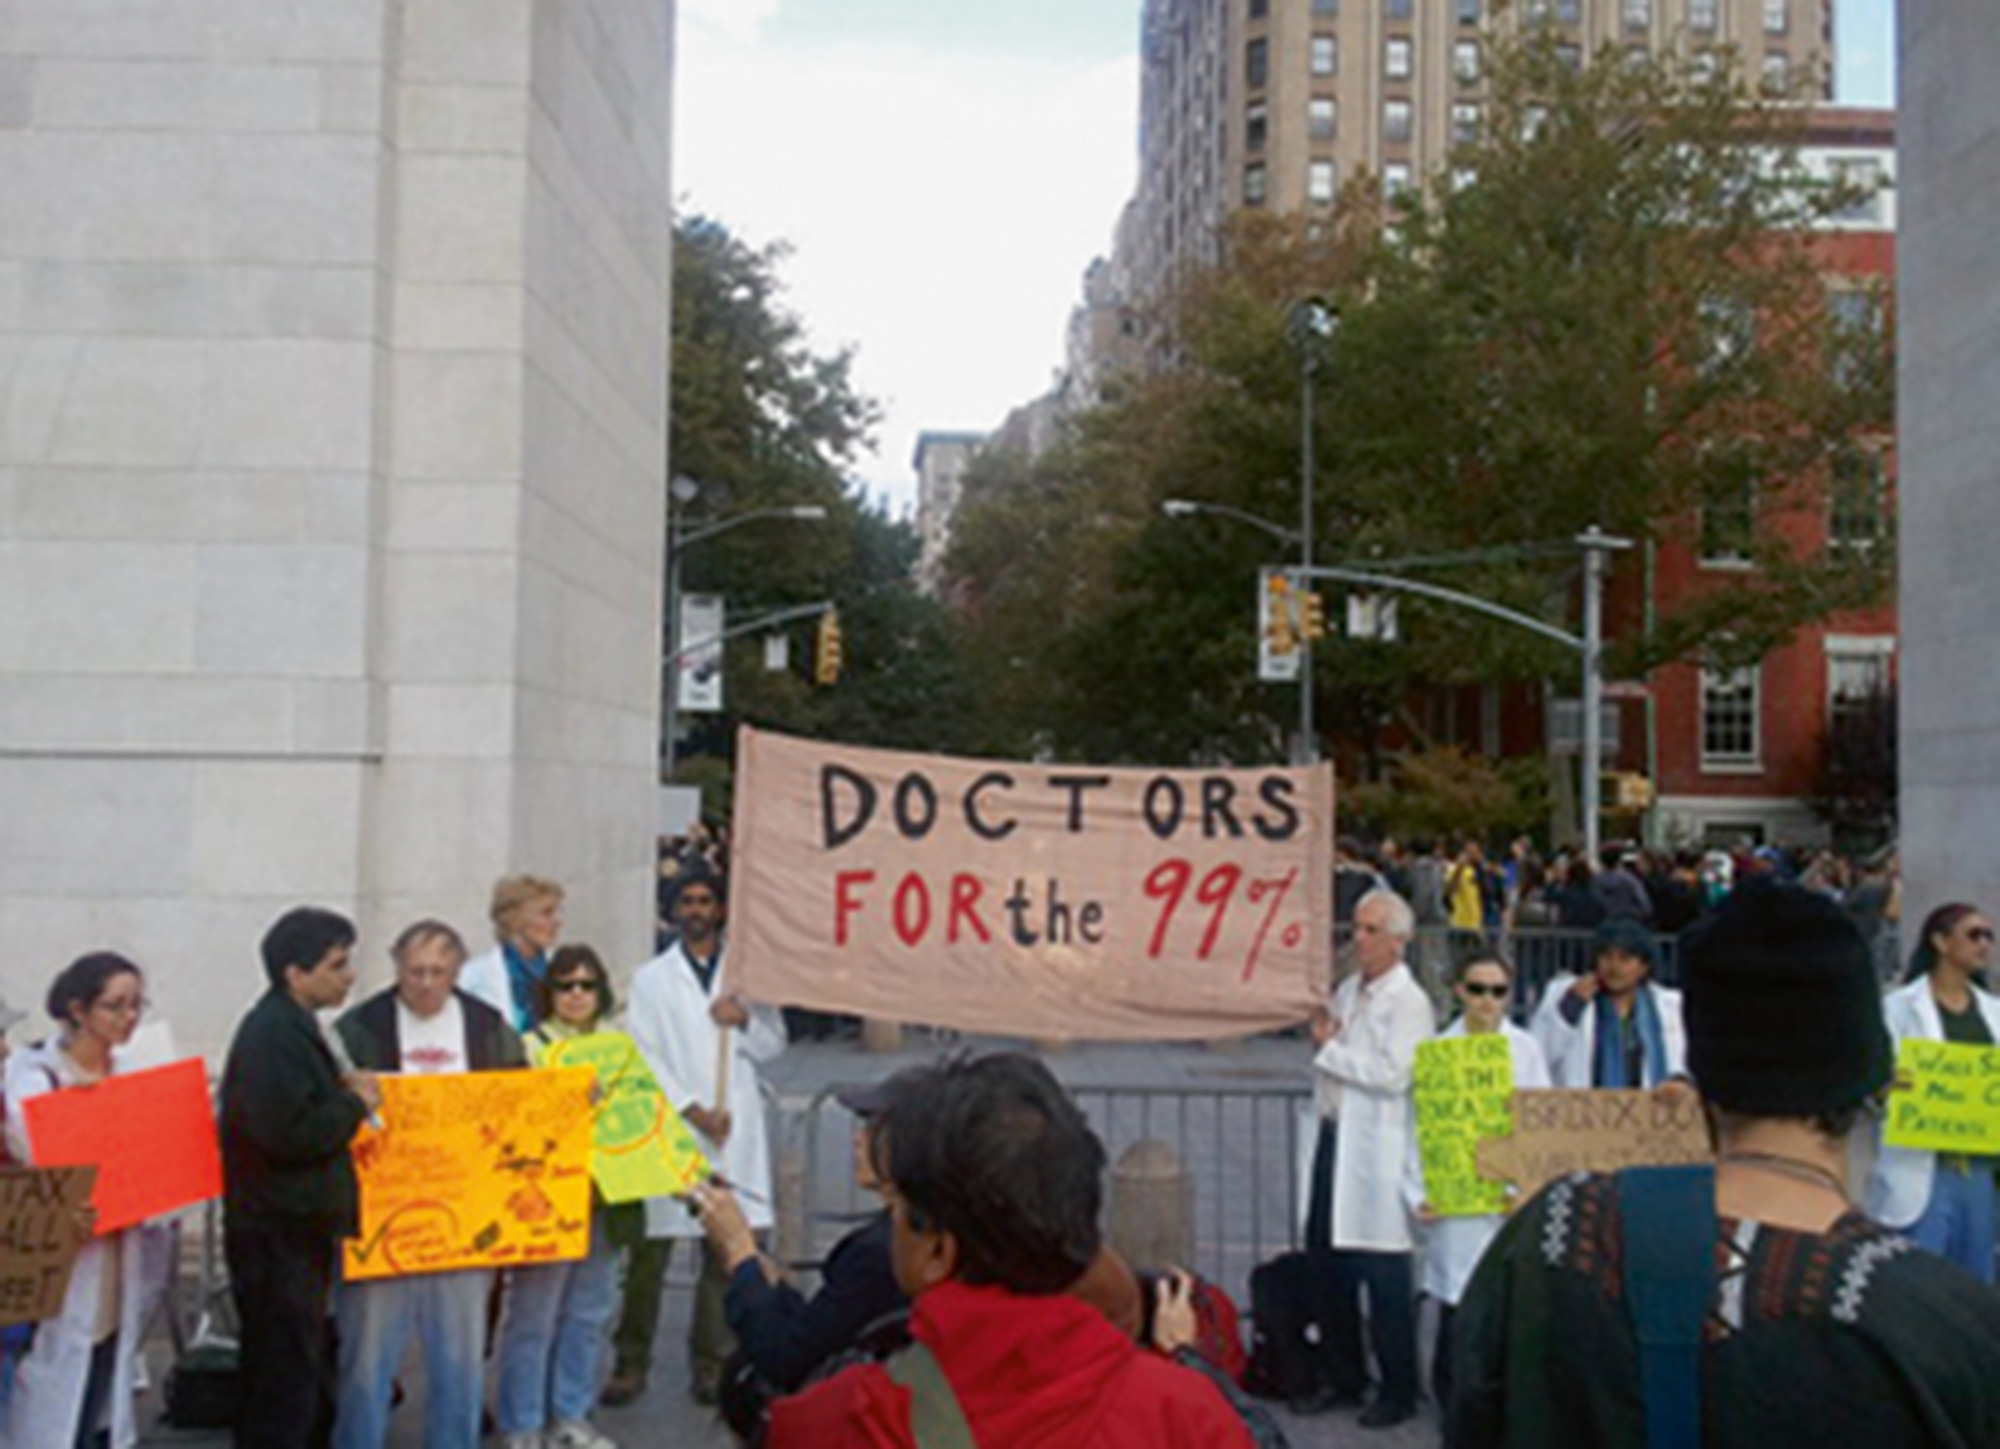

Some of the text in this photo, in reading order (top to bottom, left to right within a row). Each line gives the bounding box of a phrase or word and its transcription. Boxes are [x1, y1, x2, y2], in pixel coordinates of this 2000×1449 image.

[820, 763, 1300, 850] DOCTORS
[834, 858, 1302, 983] FOR the 99%
